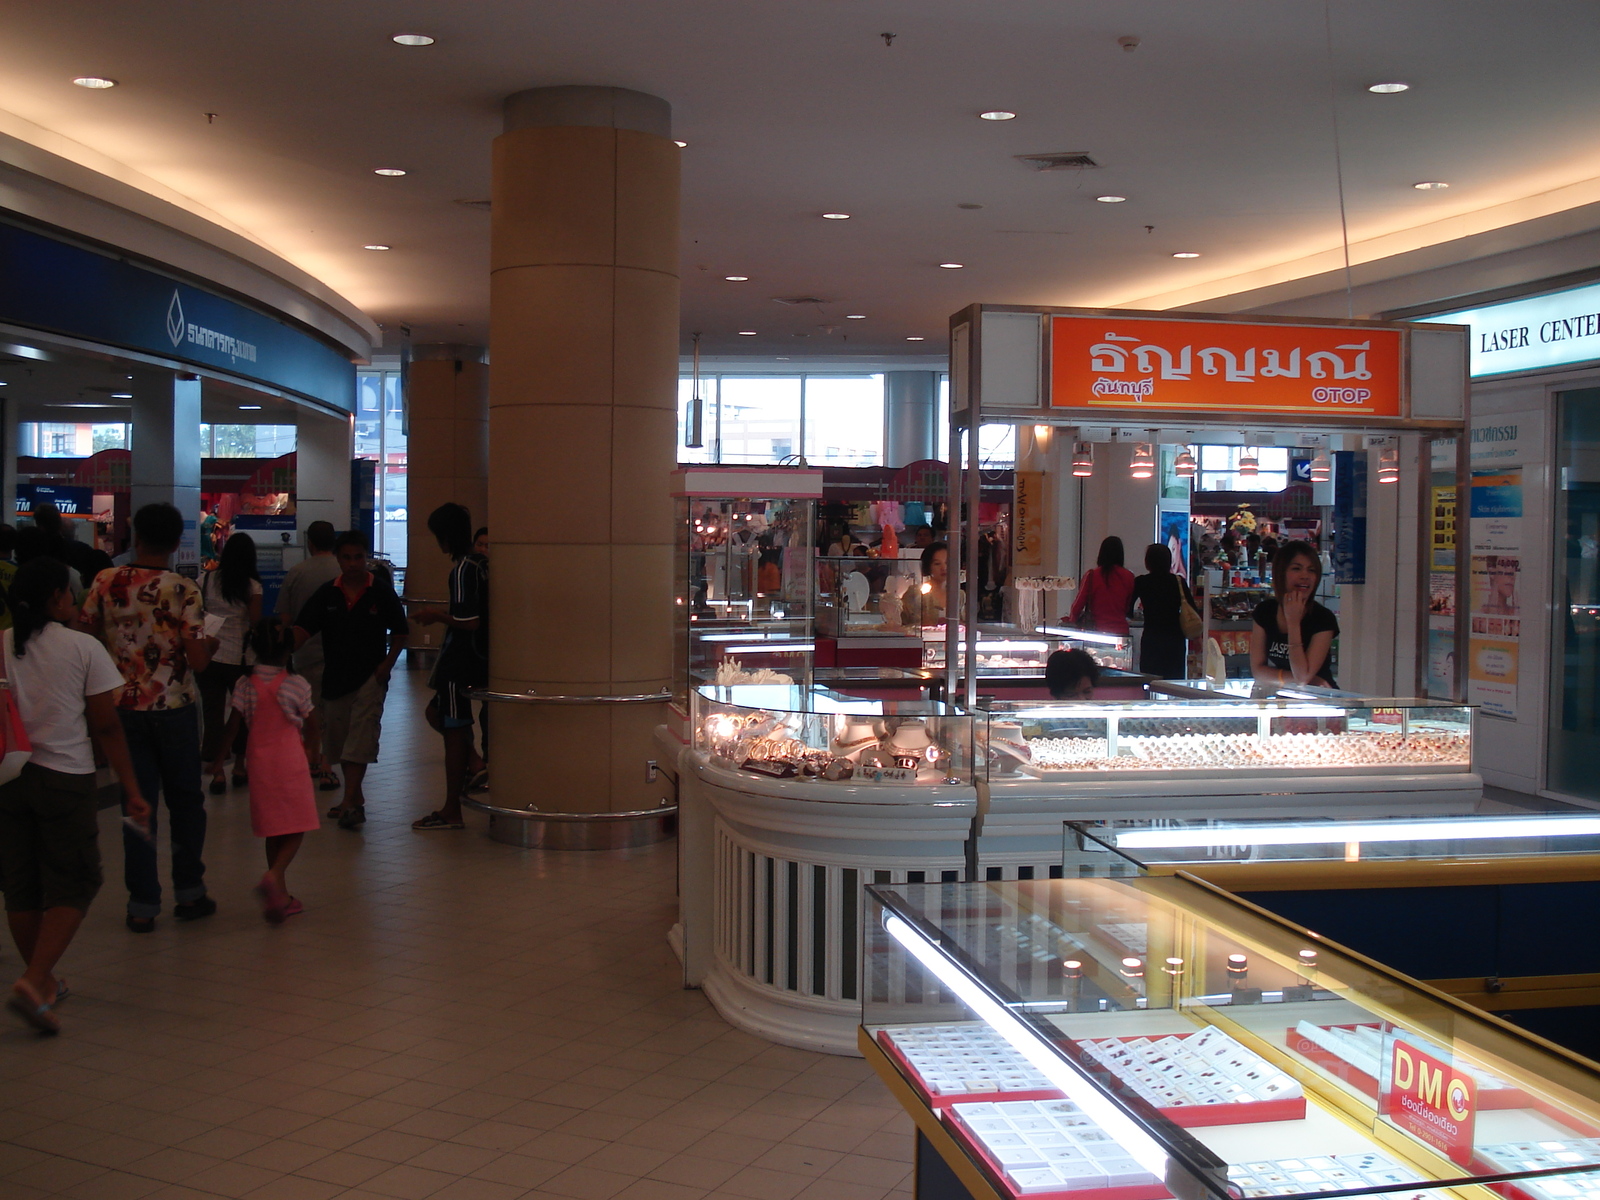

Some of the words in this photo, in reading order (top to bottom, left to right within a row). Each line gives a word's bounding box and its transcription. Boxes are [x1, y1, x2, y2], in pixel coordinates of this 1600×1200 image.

[187, 323, 257, 364] ธนาคารกรุงเทพ
[1480, 326, 1530, 353] LASER
[1089, 332, 1373, 382] ธัญญมณี
[1091, 377, 1154, 402] จันทบุรี
[1312, 386, 1372, 403] OTOP
[1394, 1047, 1470, 1122] DMC
